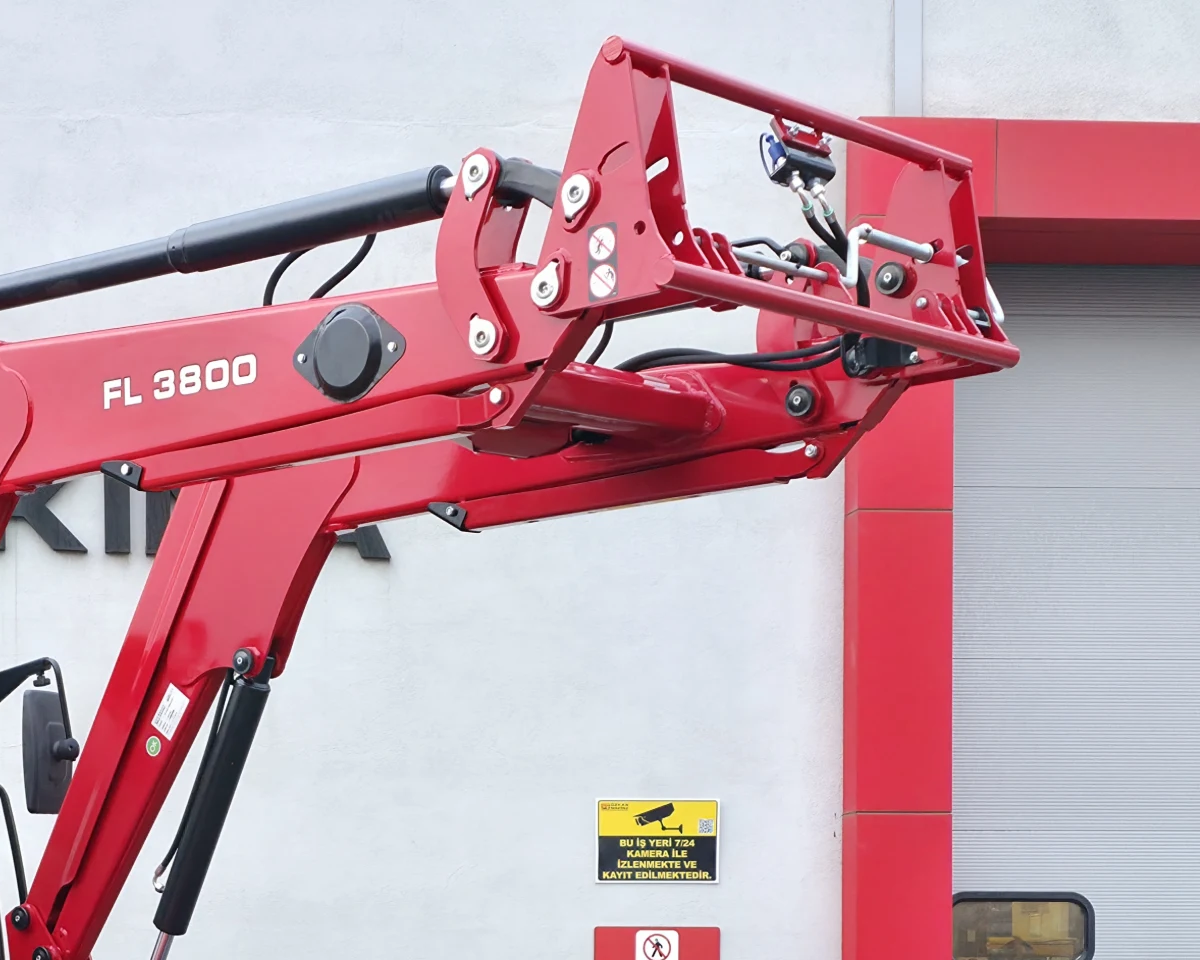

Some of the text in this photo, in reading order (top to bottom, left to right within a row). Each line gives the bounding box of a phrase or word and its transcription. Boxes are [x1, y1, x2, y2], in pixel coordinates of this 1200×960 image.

[103, 353, 257, 410] FL 3800
[619, 838, 696, 849] BU İŞ YERİ 7/24
[627, 849, 688, 858] KAMERA İLE
[617, 859, 698, 869] İZLENMEKTE VE
[602, 869, 712, 879] KAYIT EDİLMEKTEDİR.
